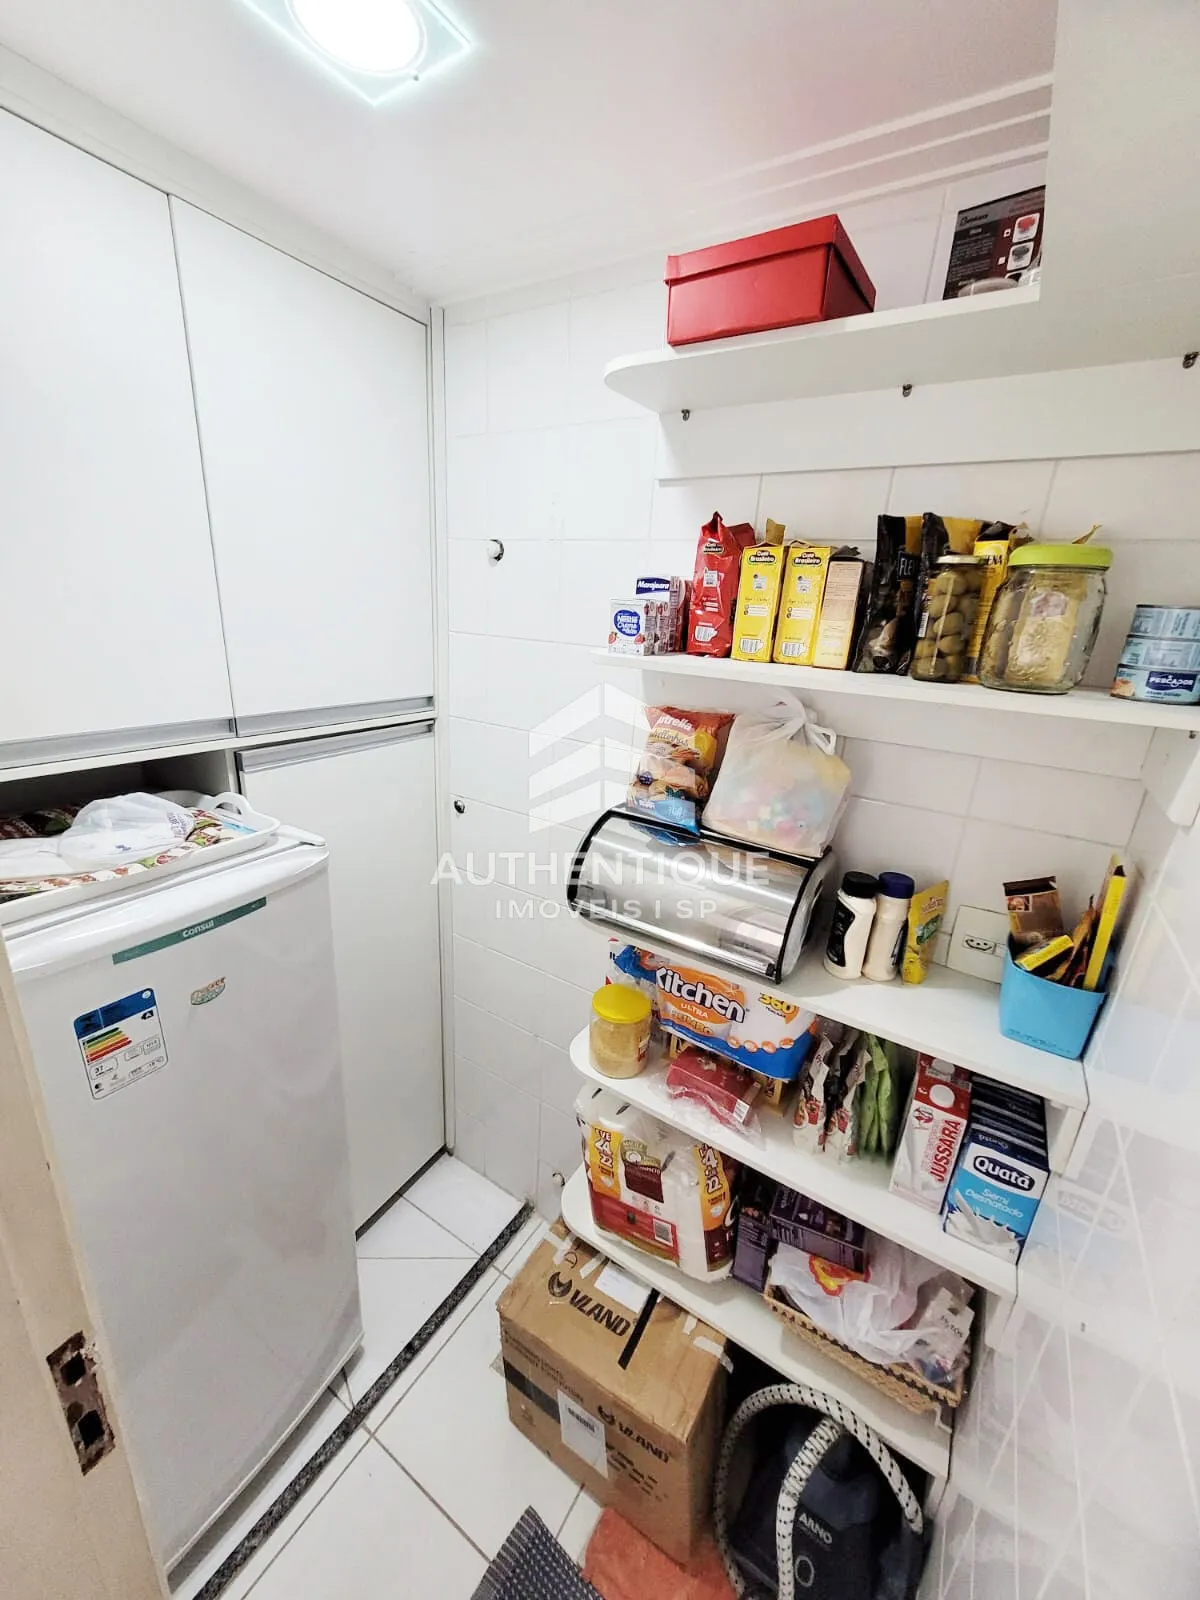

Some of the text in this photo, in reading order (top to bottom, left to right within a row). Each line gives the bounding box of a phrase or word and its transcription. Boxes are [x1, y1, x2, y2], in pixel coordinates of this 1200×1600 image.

[183, 920, 214, 937] Consul
[681, 1003, 709, 1018] ULTRA
[930, 1120, 961, 1182] JUSSARA
[975, 1157, 1030, 1190] Quatá
[569, 1288, 631, 1337] VLAND
[799, 1512, 833, 1545] ARNO
